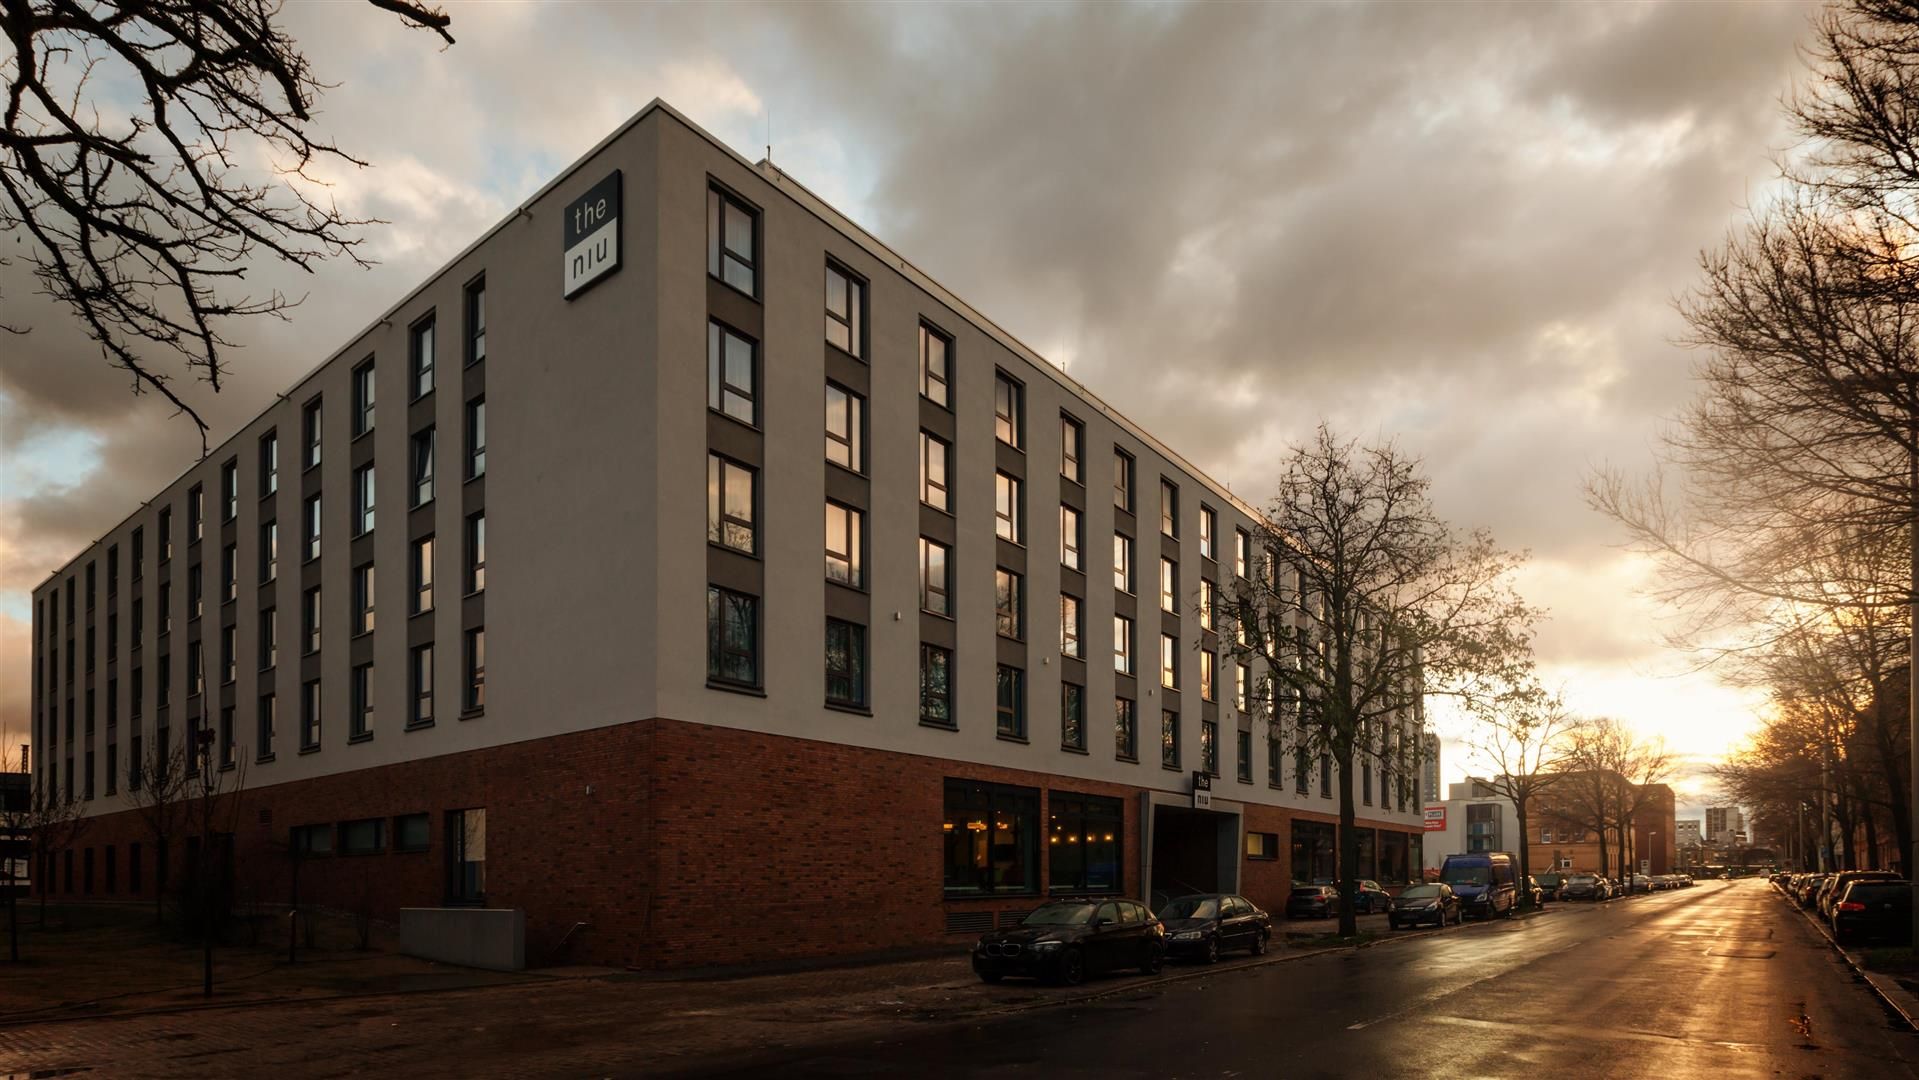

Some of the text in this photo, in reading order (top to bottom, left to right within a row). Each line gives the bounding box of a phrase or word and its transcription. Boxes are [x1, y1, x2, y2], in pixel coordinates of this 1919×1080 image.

[575, 198, 606, 234] the
[573, 238, 607, 279] niu
[1198, 775, 1208, 788] the
[1197, 795, 1208, 804] niu
